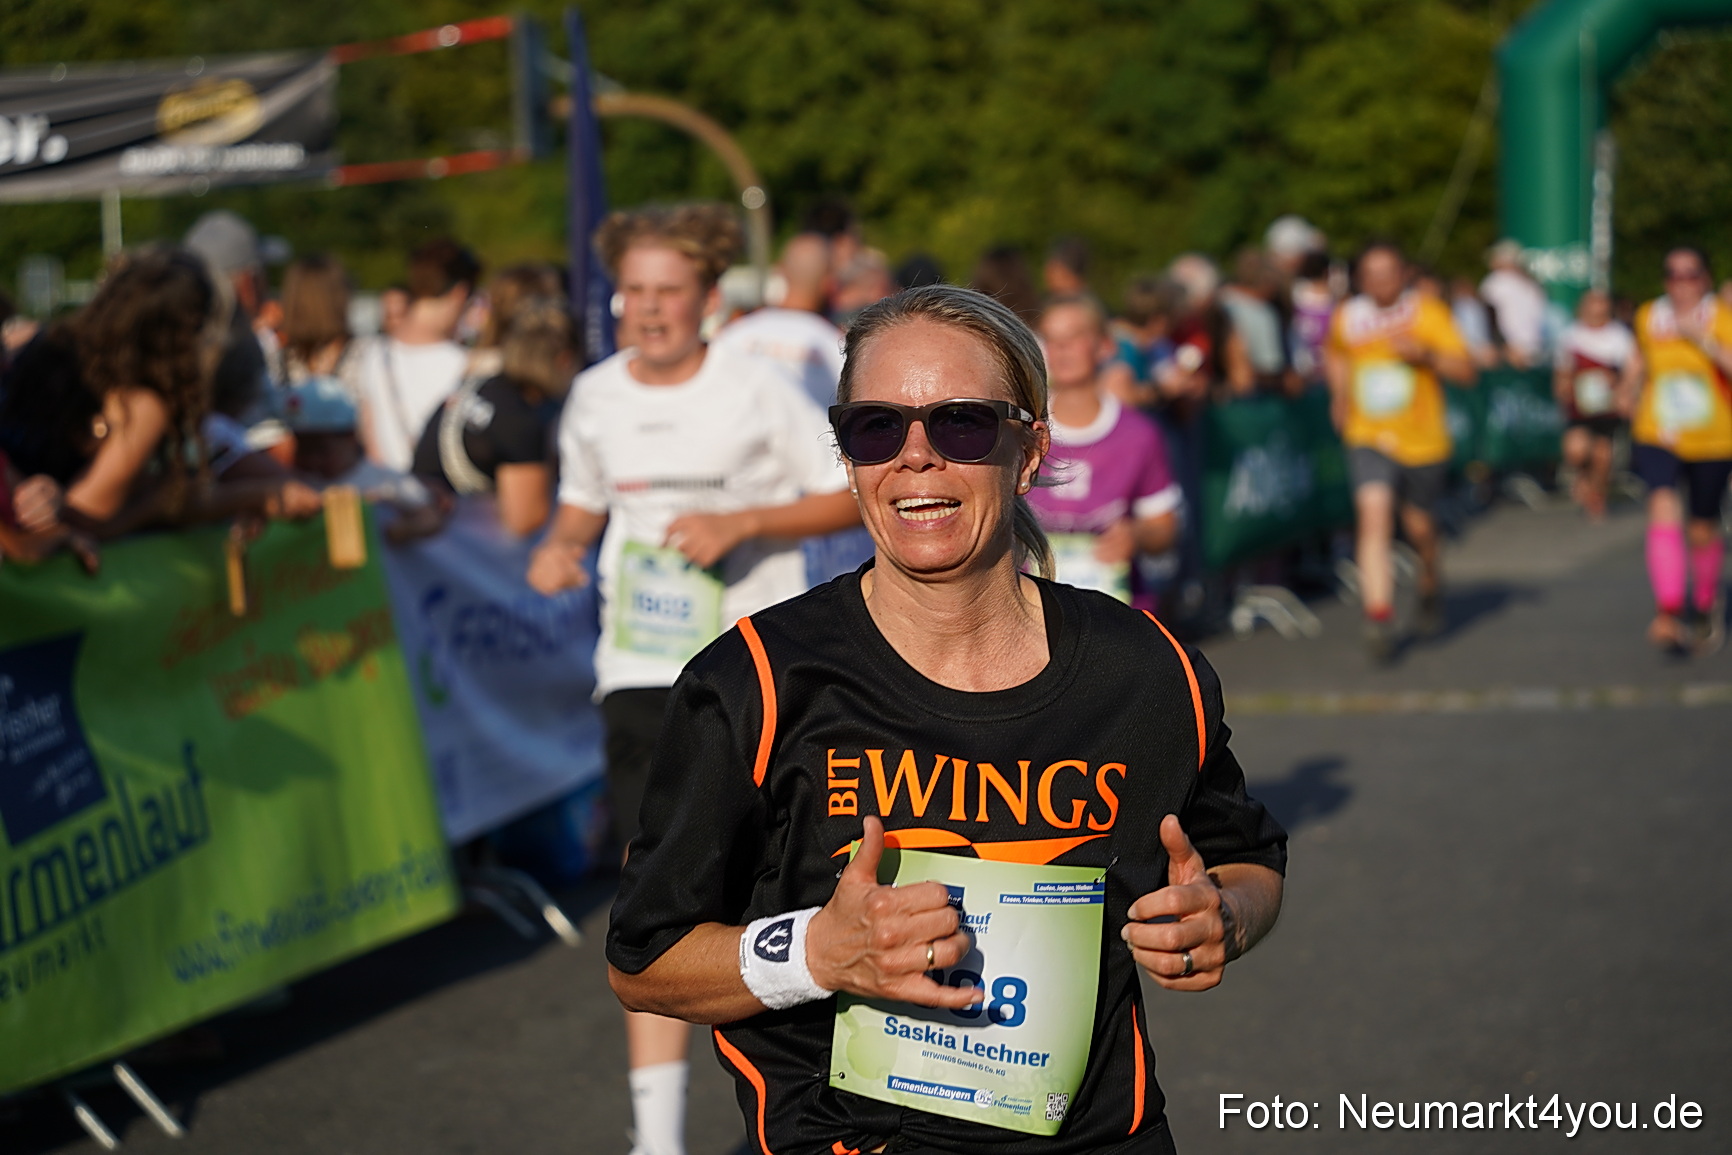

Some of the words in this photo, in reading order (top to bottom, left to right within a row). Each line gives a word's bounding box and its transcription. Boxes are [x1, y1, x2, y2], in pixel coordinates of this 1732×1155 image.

[828, 749, 861, 818] BIT
[865, 749, 1127, 831] WINGS
[883, 1015, 957, 1050] Saskia
[962, 1034, 1051, 1068] Lechner
[921, 1050, 957, 1064] BITWINGS
[957, 1057, 978, 1071] GmbH
[890, 1077, 972, 1102] firmenlauf.bayern
